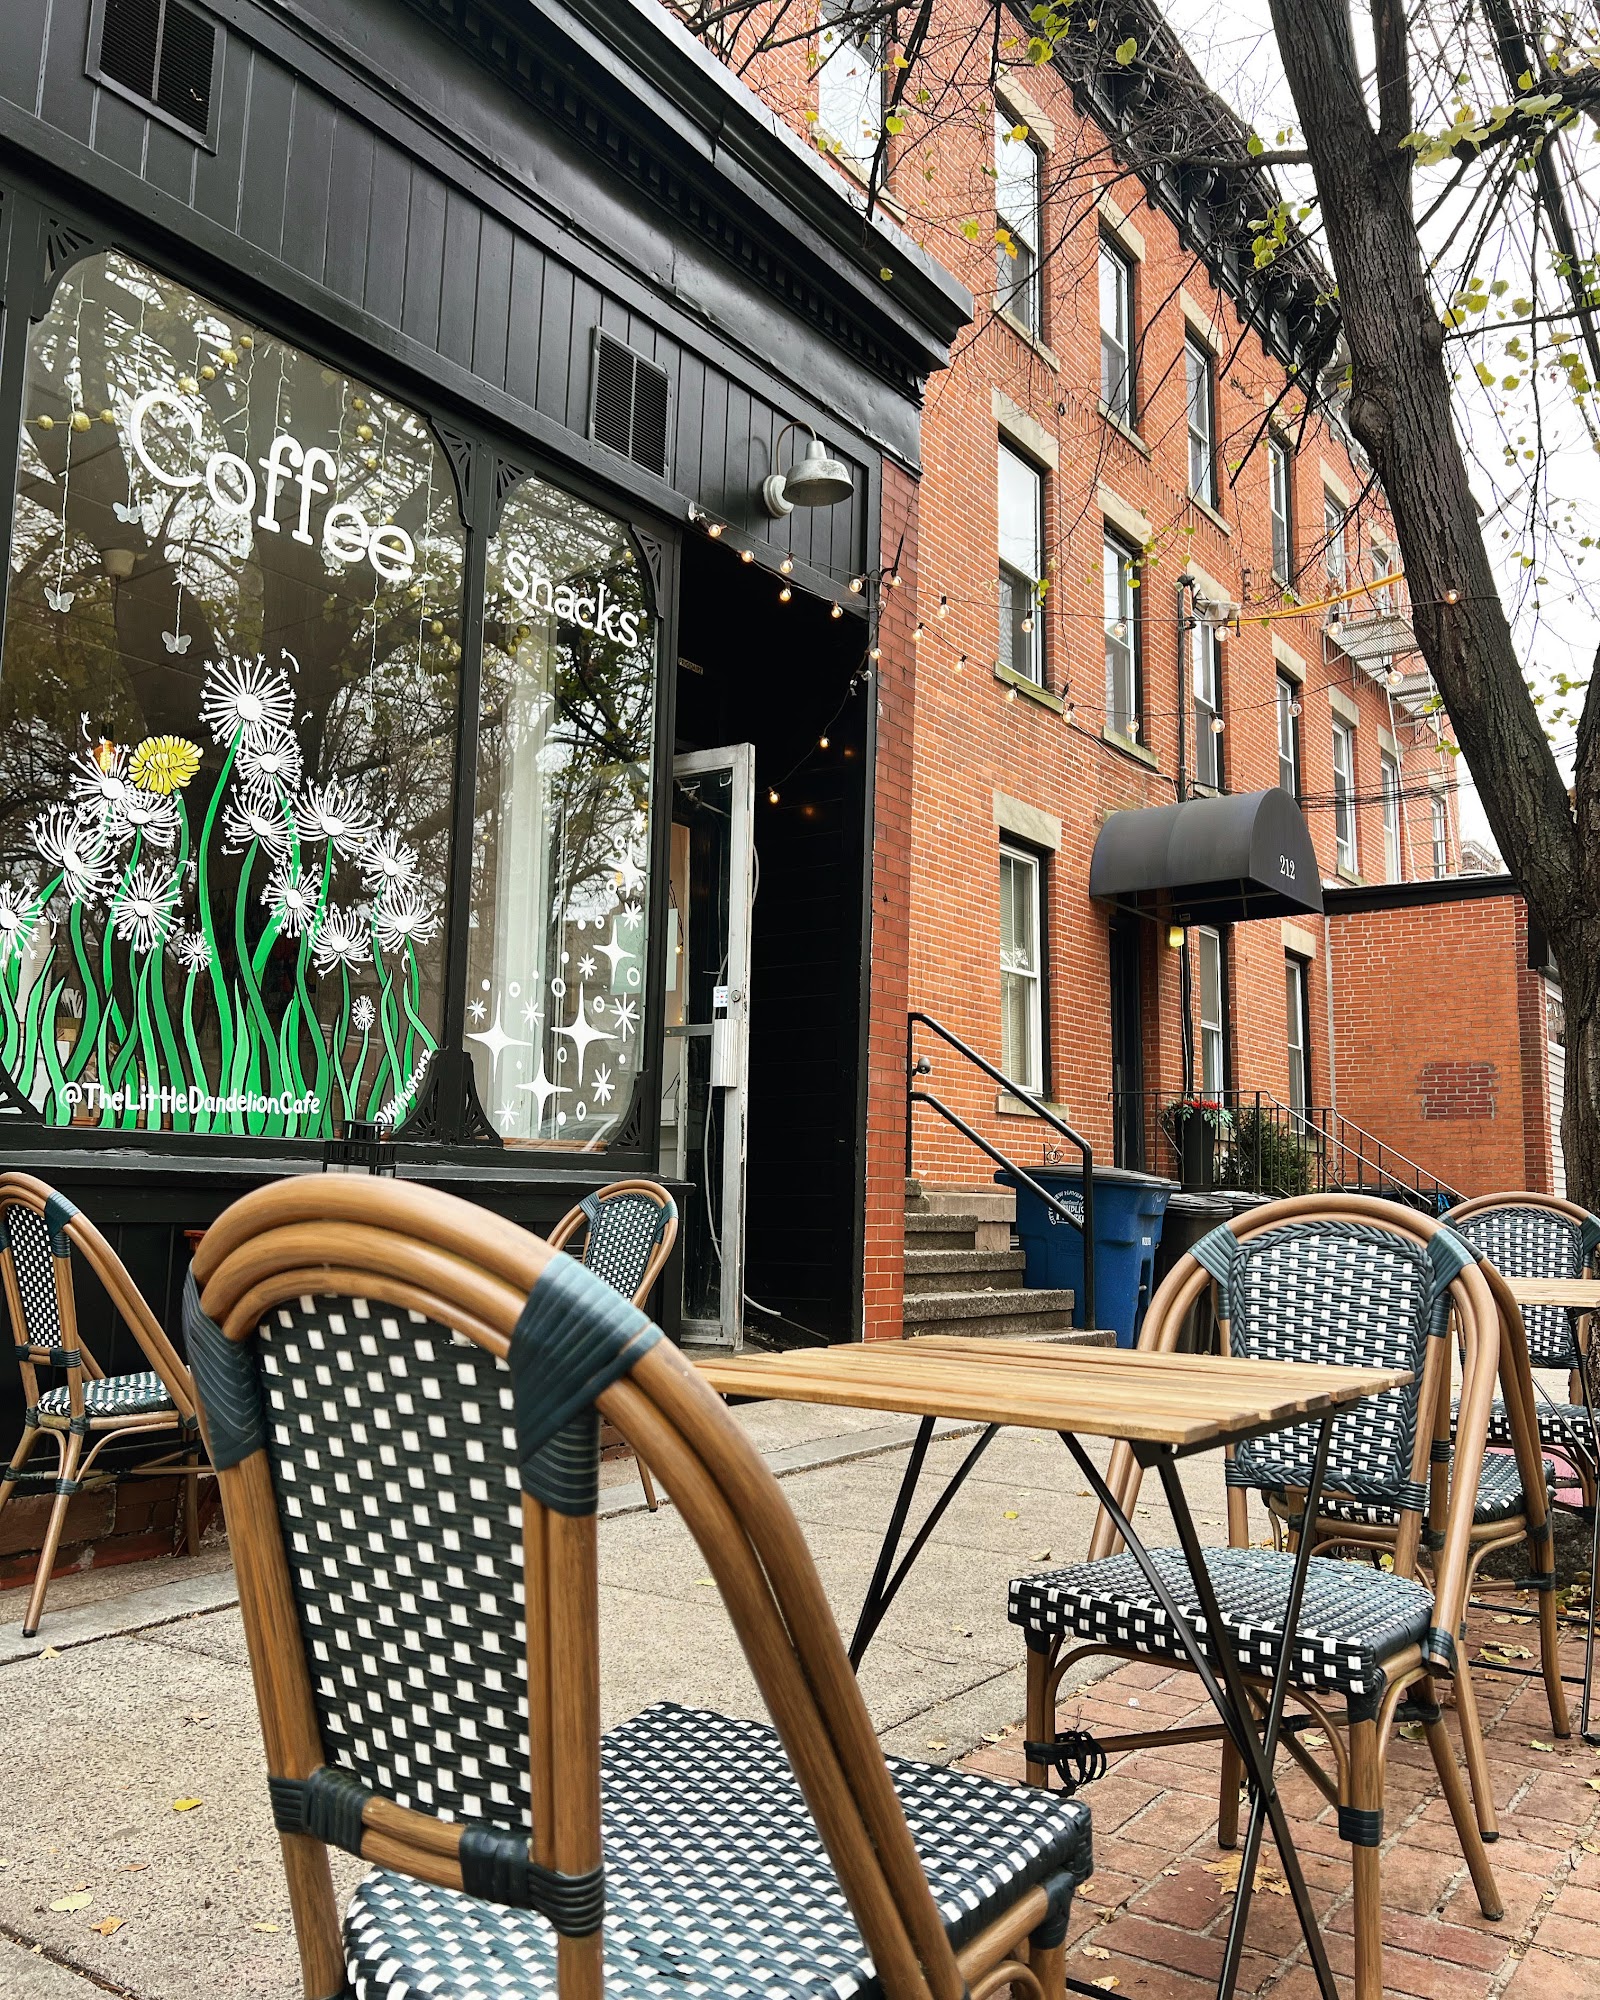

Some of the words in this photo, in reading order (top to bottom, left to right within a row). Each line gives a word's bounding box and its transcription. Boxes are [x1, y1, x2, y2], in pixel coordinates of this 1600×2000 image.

[130, 389, 416, 581] Coffee
[503, 550, 640, 648] Snacks
[1280, 855, 1296, 880] 212
[59, 1081, 321, 1115] @TheLittleDandelionCafe
